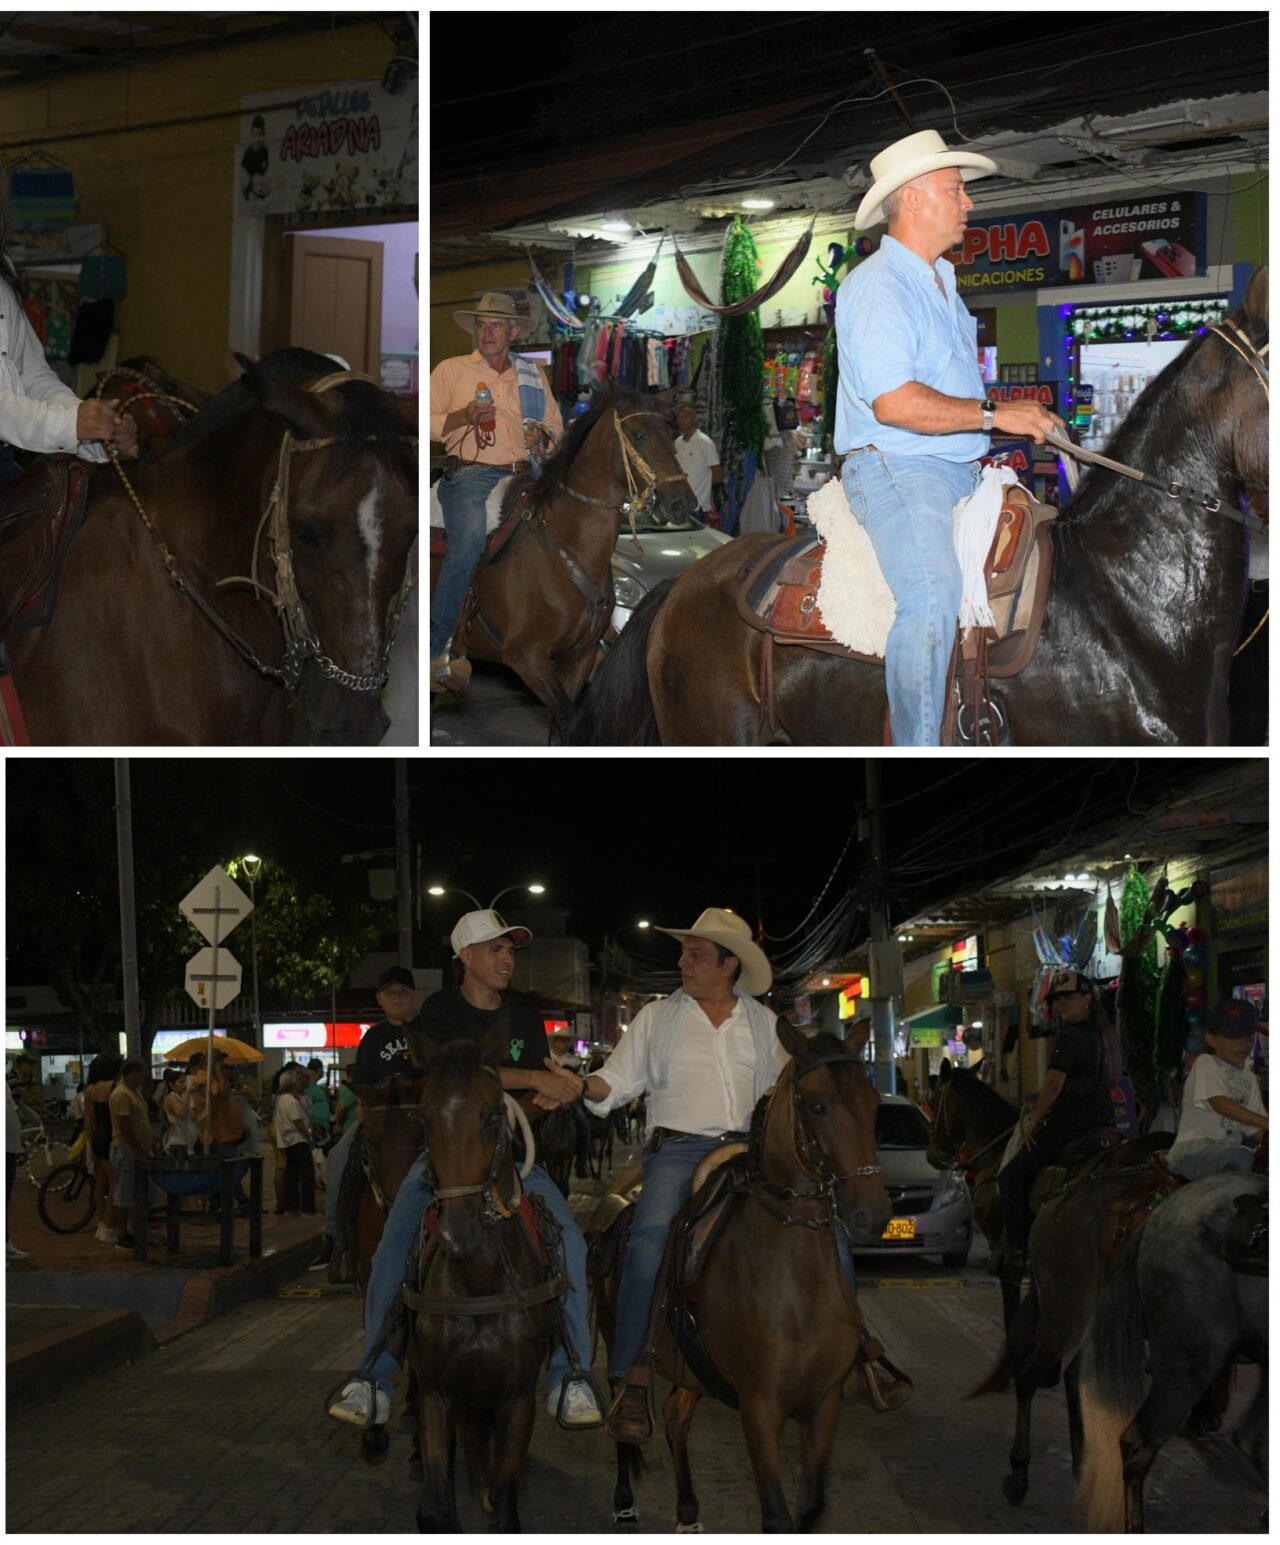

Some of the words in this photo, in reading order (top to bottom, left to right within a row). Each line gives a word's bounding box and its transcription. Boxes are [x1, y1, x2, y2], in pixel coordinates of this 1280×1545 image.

[280, 115, 381, 163] ARIADNA
[1092, 202, 1167, 221] CELULARES
[1170, 200, 1181, 212] &
[1093, 217, 1180, 237] ACCESORIOS
[956, 267, 1045, 288] NICACIONES
[988, 384, 1053, 406] ALPHA
